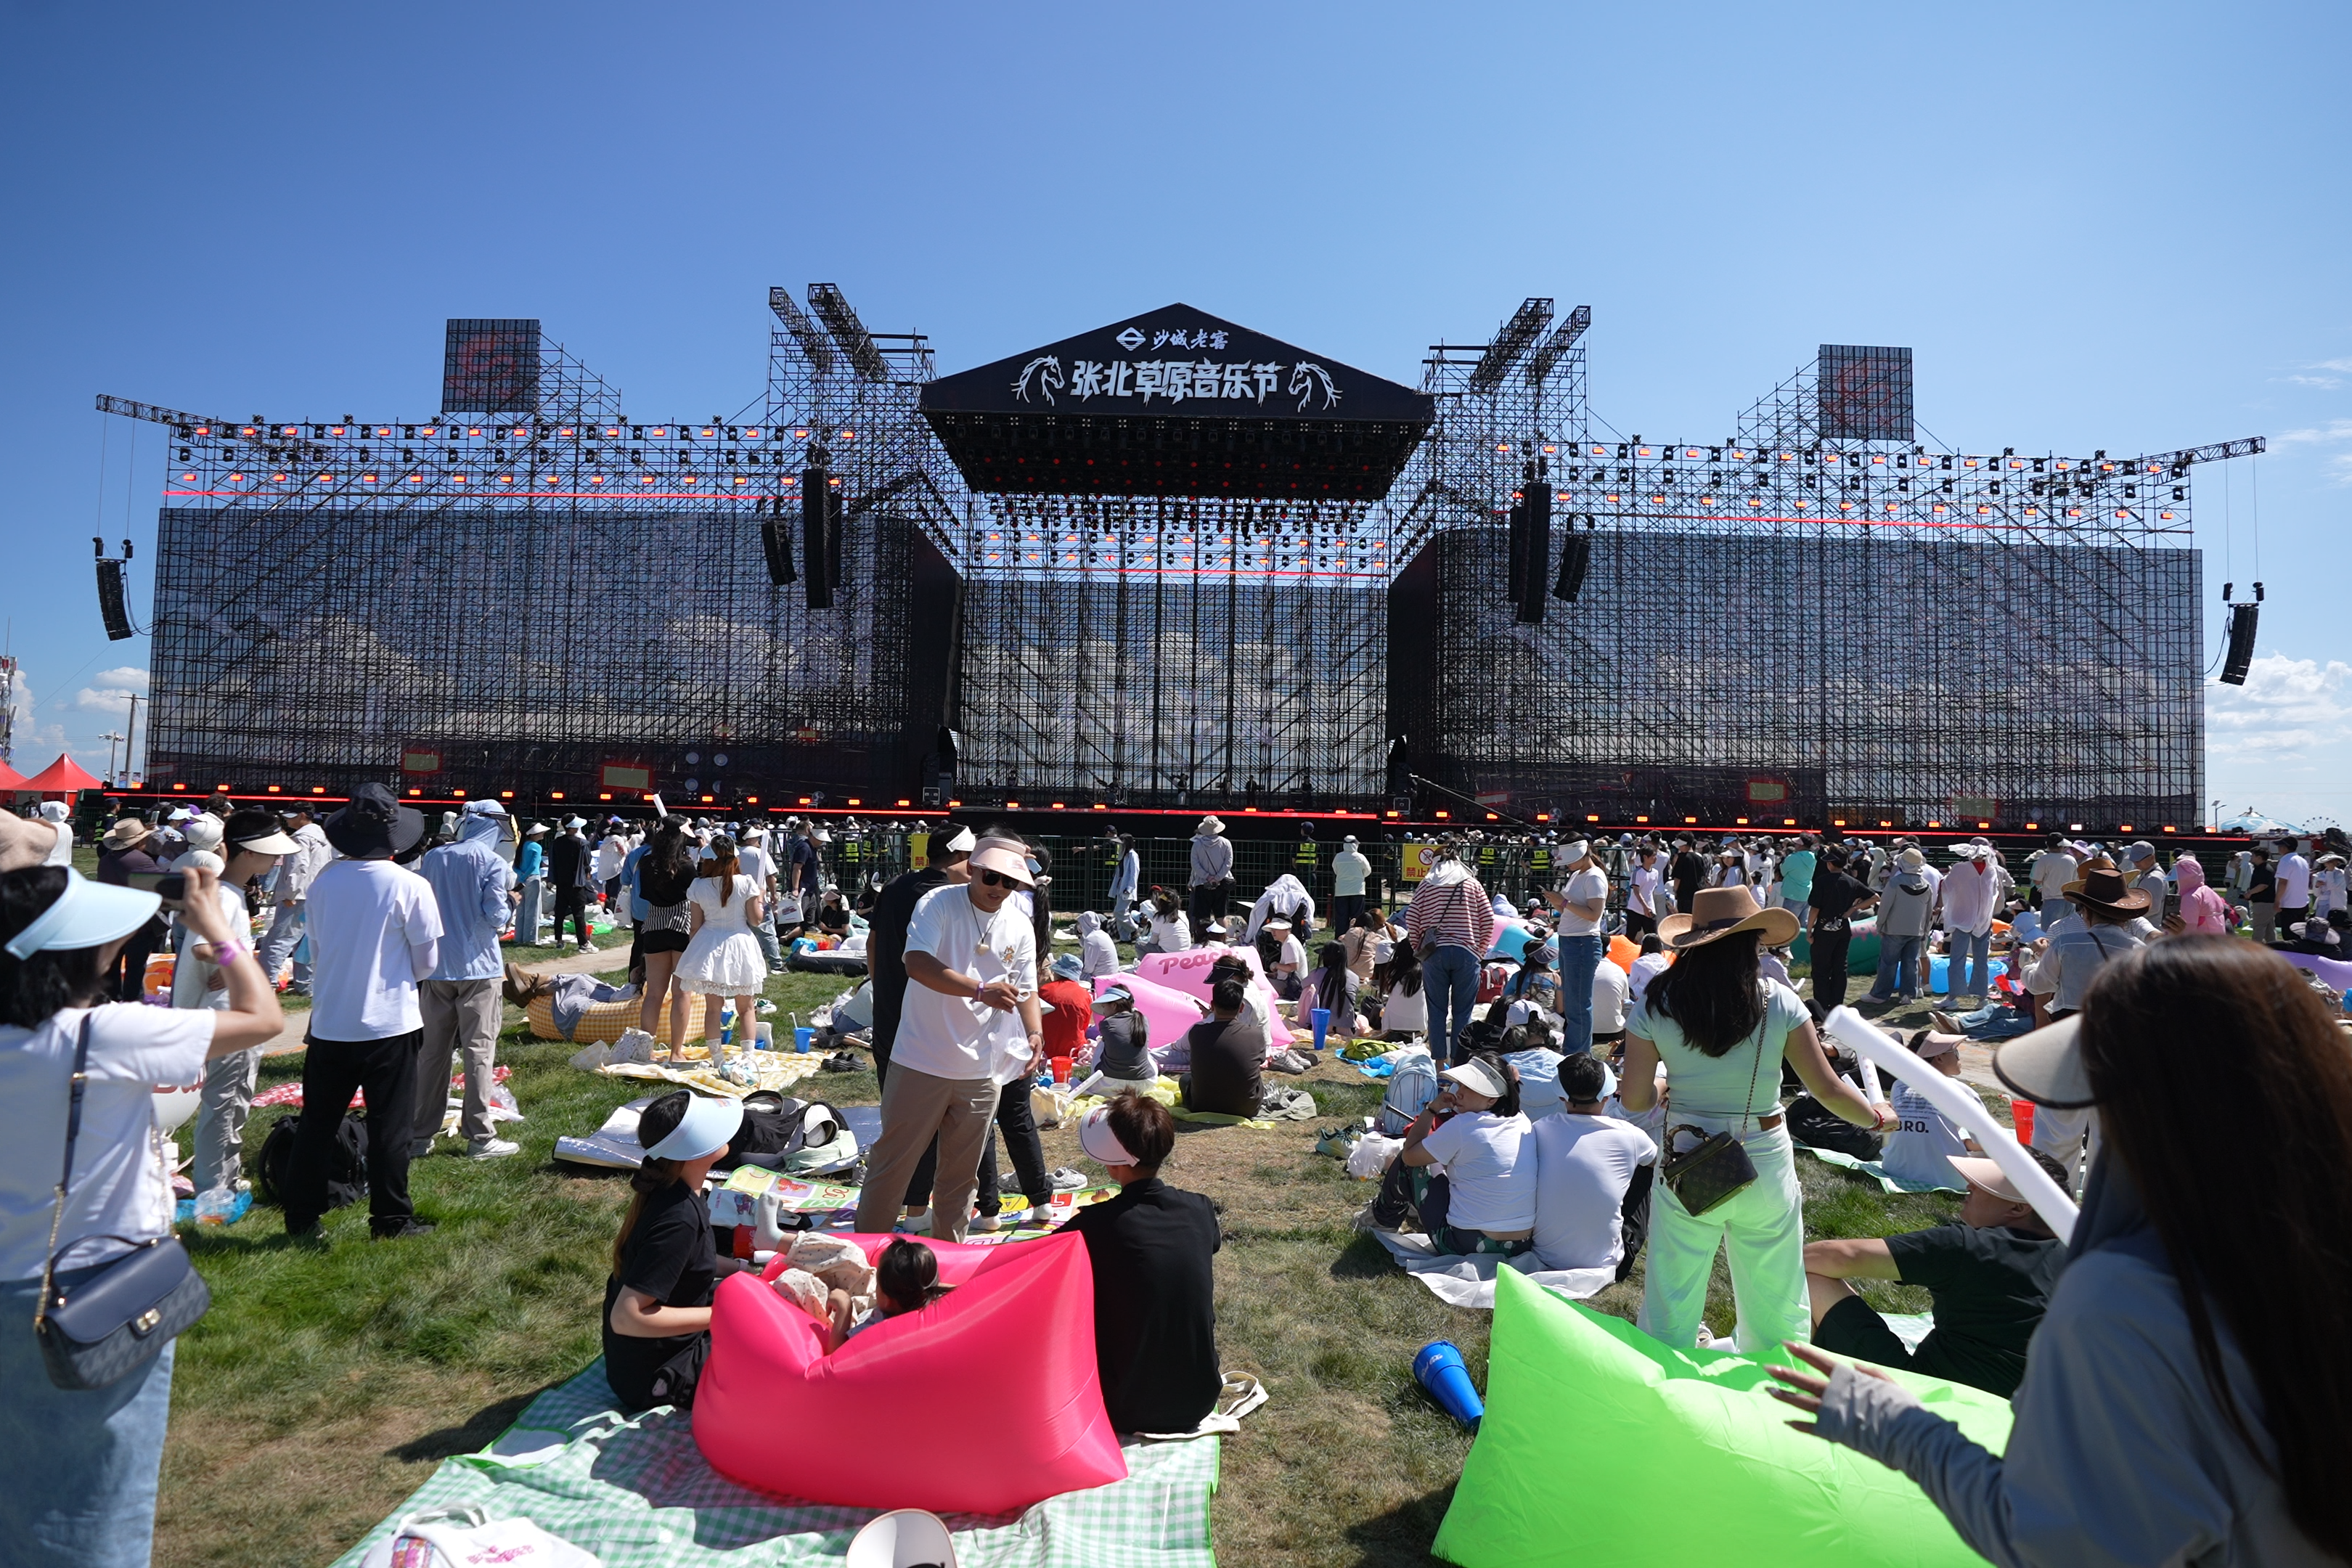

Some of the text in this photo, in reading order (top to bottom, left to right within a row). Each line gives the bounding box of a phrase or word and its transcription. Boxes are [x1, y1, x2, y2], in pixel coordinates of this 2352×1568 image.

[1151, 329, 1229, 351] 沙城老窖
[1070, 356, 1288, 407] 张北草原音乐节
[1406, 867, 1430, 878] 禁止
